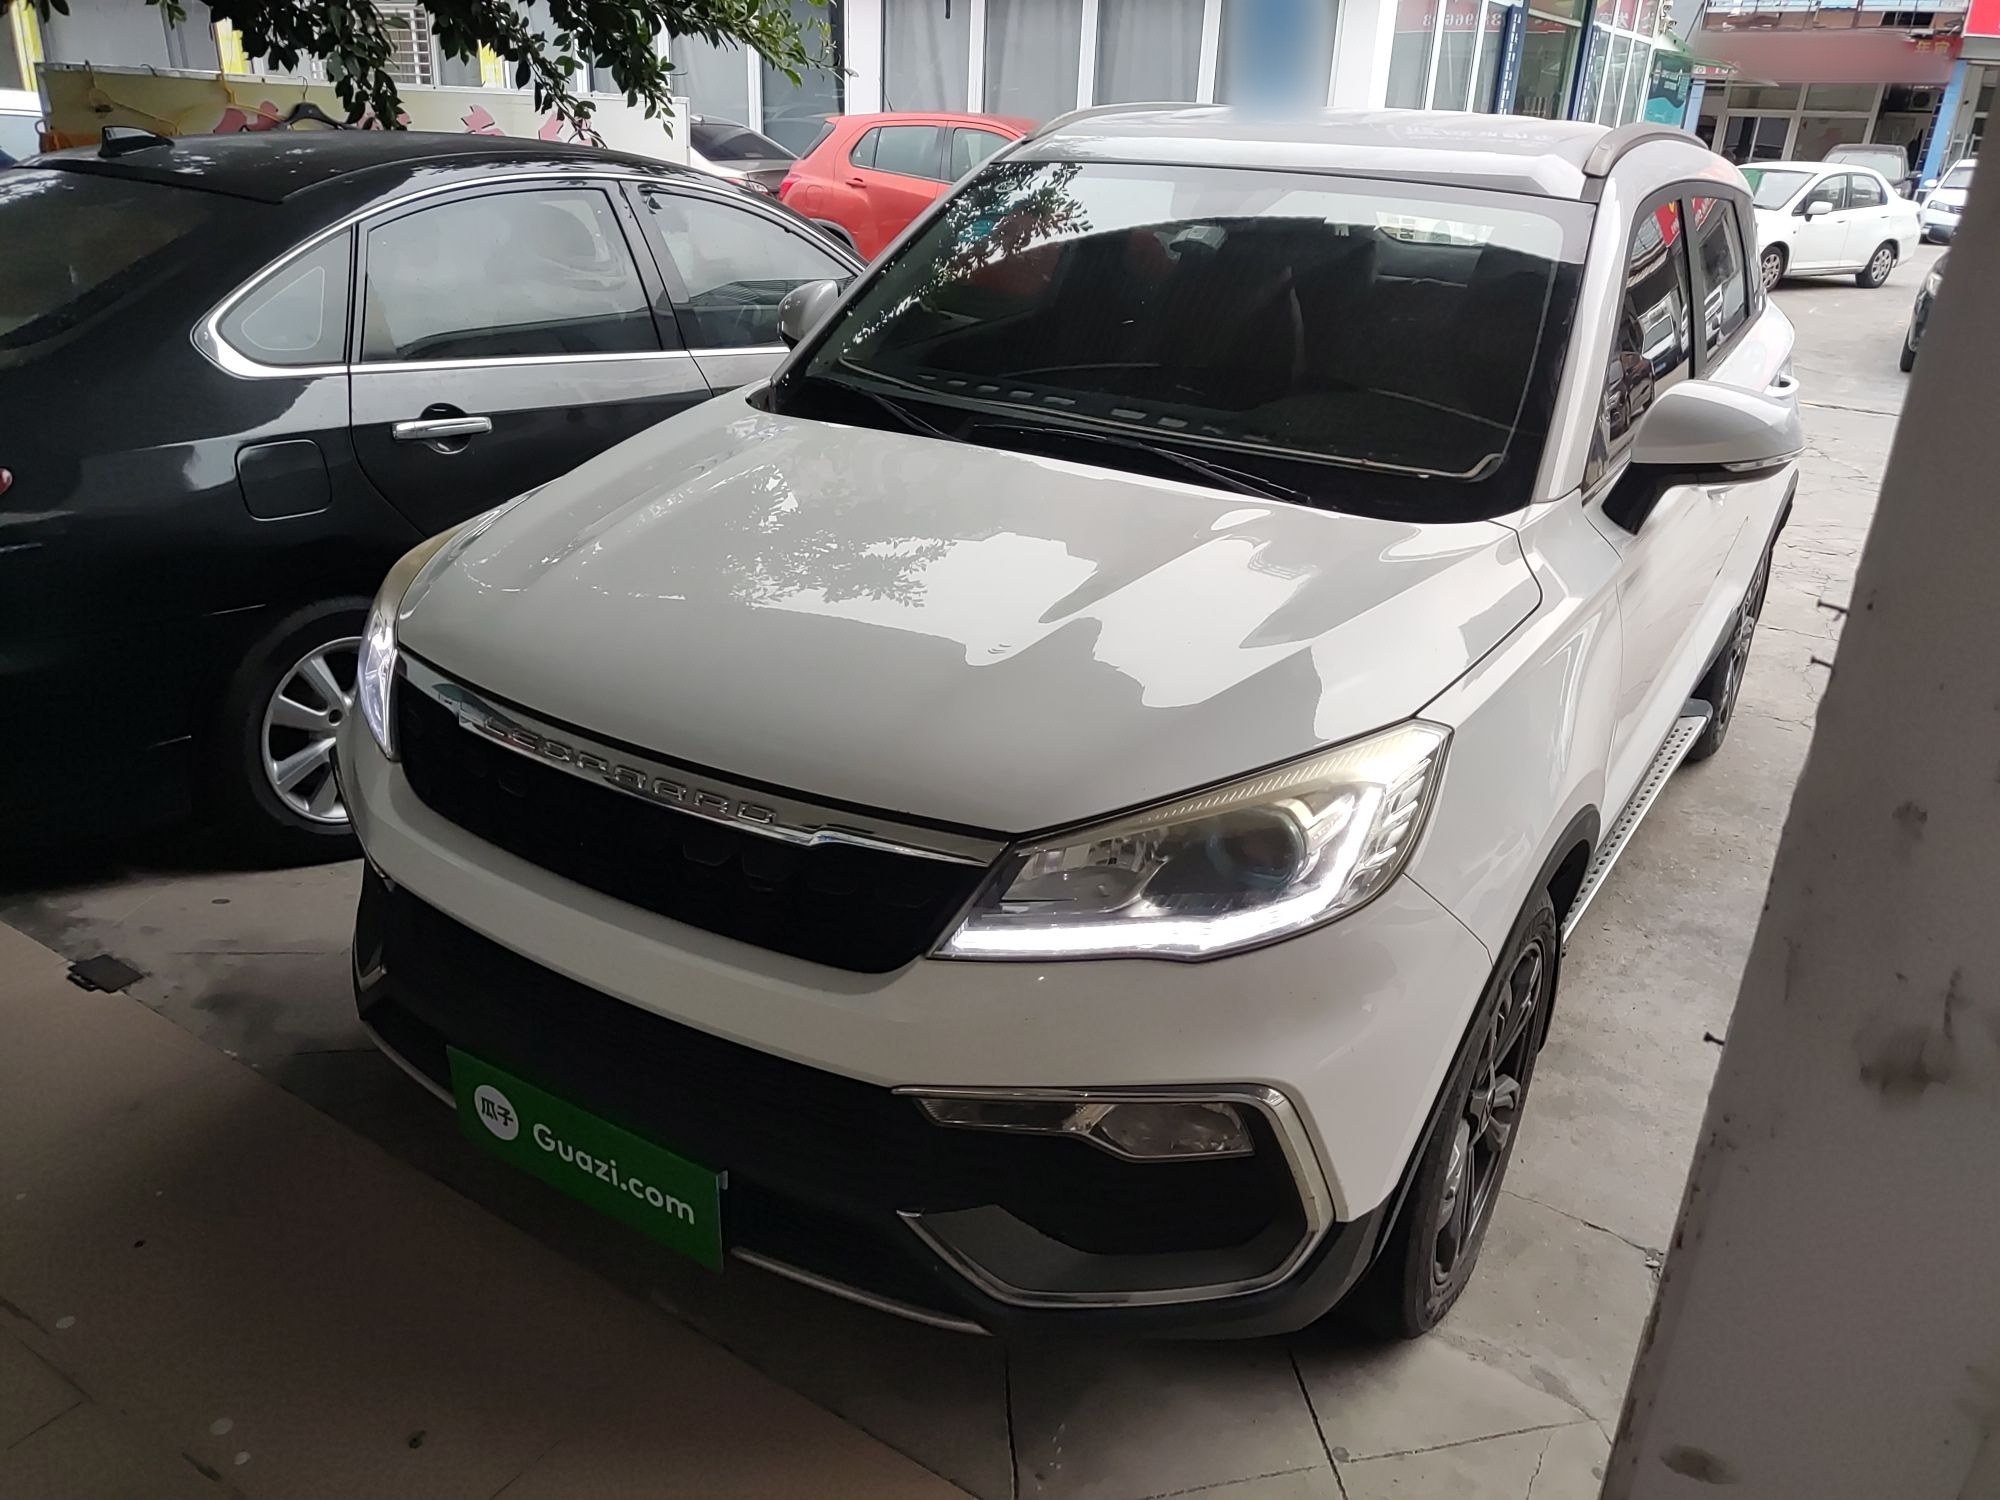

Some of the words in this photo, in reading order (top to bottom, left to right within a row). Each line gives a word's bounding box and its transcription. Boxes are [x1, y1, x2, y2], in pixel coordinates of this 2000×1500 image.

[484, 717, 776, 824] LEOPAARD
[481, 1097, 514, 1127] 瓜子
[533, 1123, 695, 1225] Guazi.com
